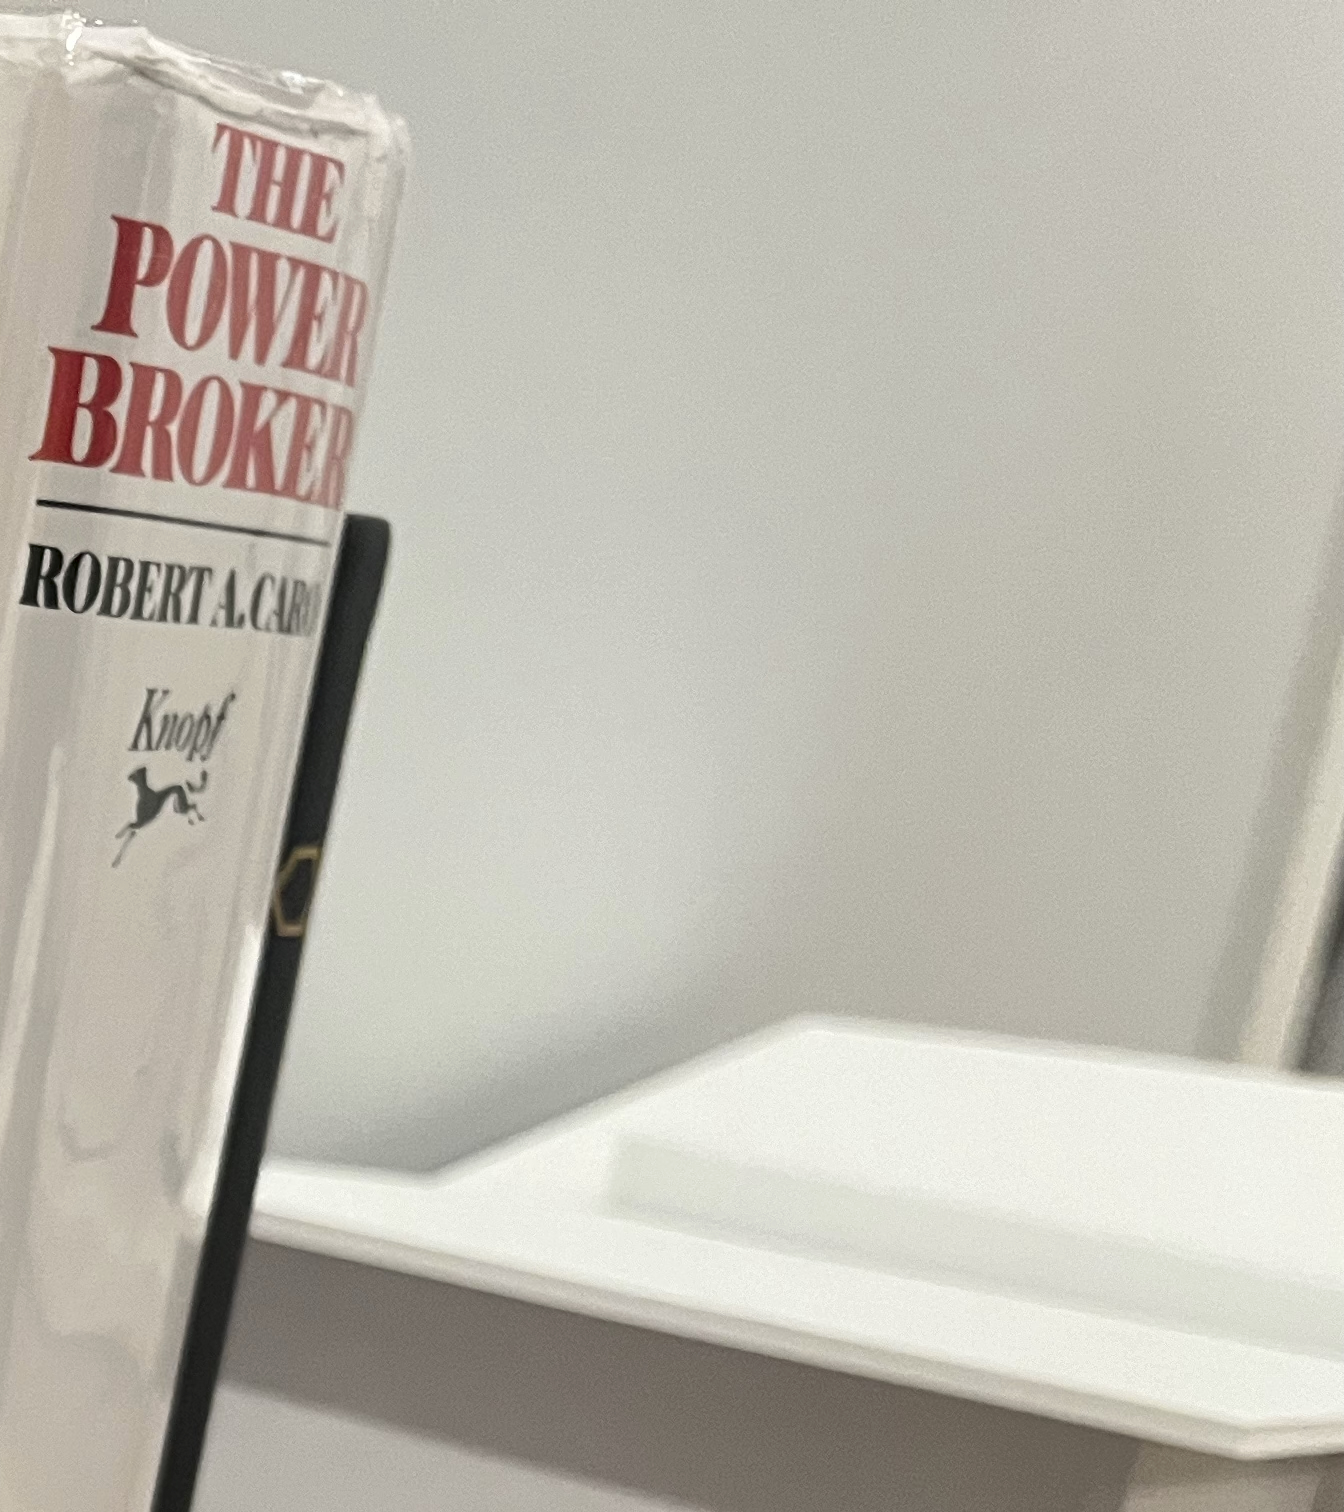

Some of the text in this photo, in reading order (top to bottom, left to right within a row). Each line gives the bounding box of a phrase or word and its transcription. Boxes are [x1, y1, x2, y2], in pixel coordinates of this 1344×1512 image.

[212, 122, 345, 244] THE
[91, 214, 369, 389] POWER
[28, 345, 355, 511] BROKER
[19, 543, 212, 626] ROBERT
[128, 686, 237, 763] Knopf
